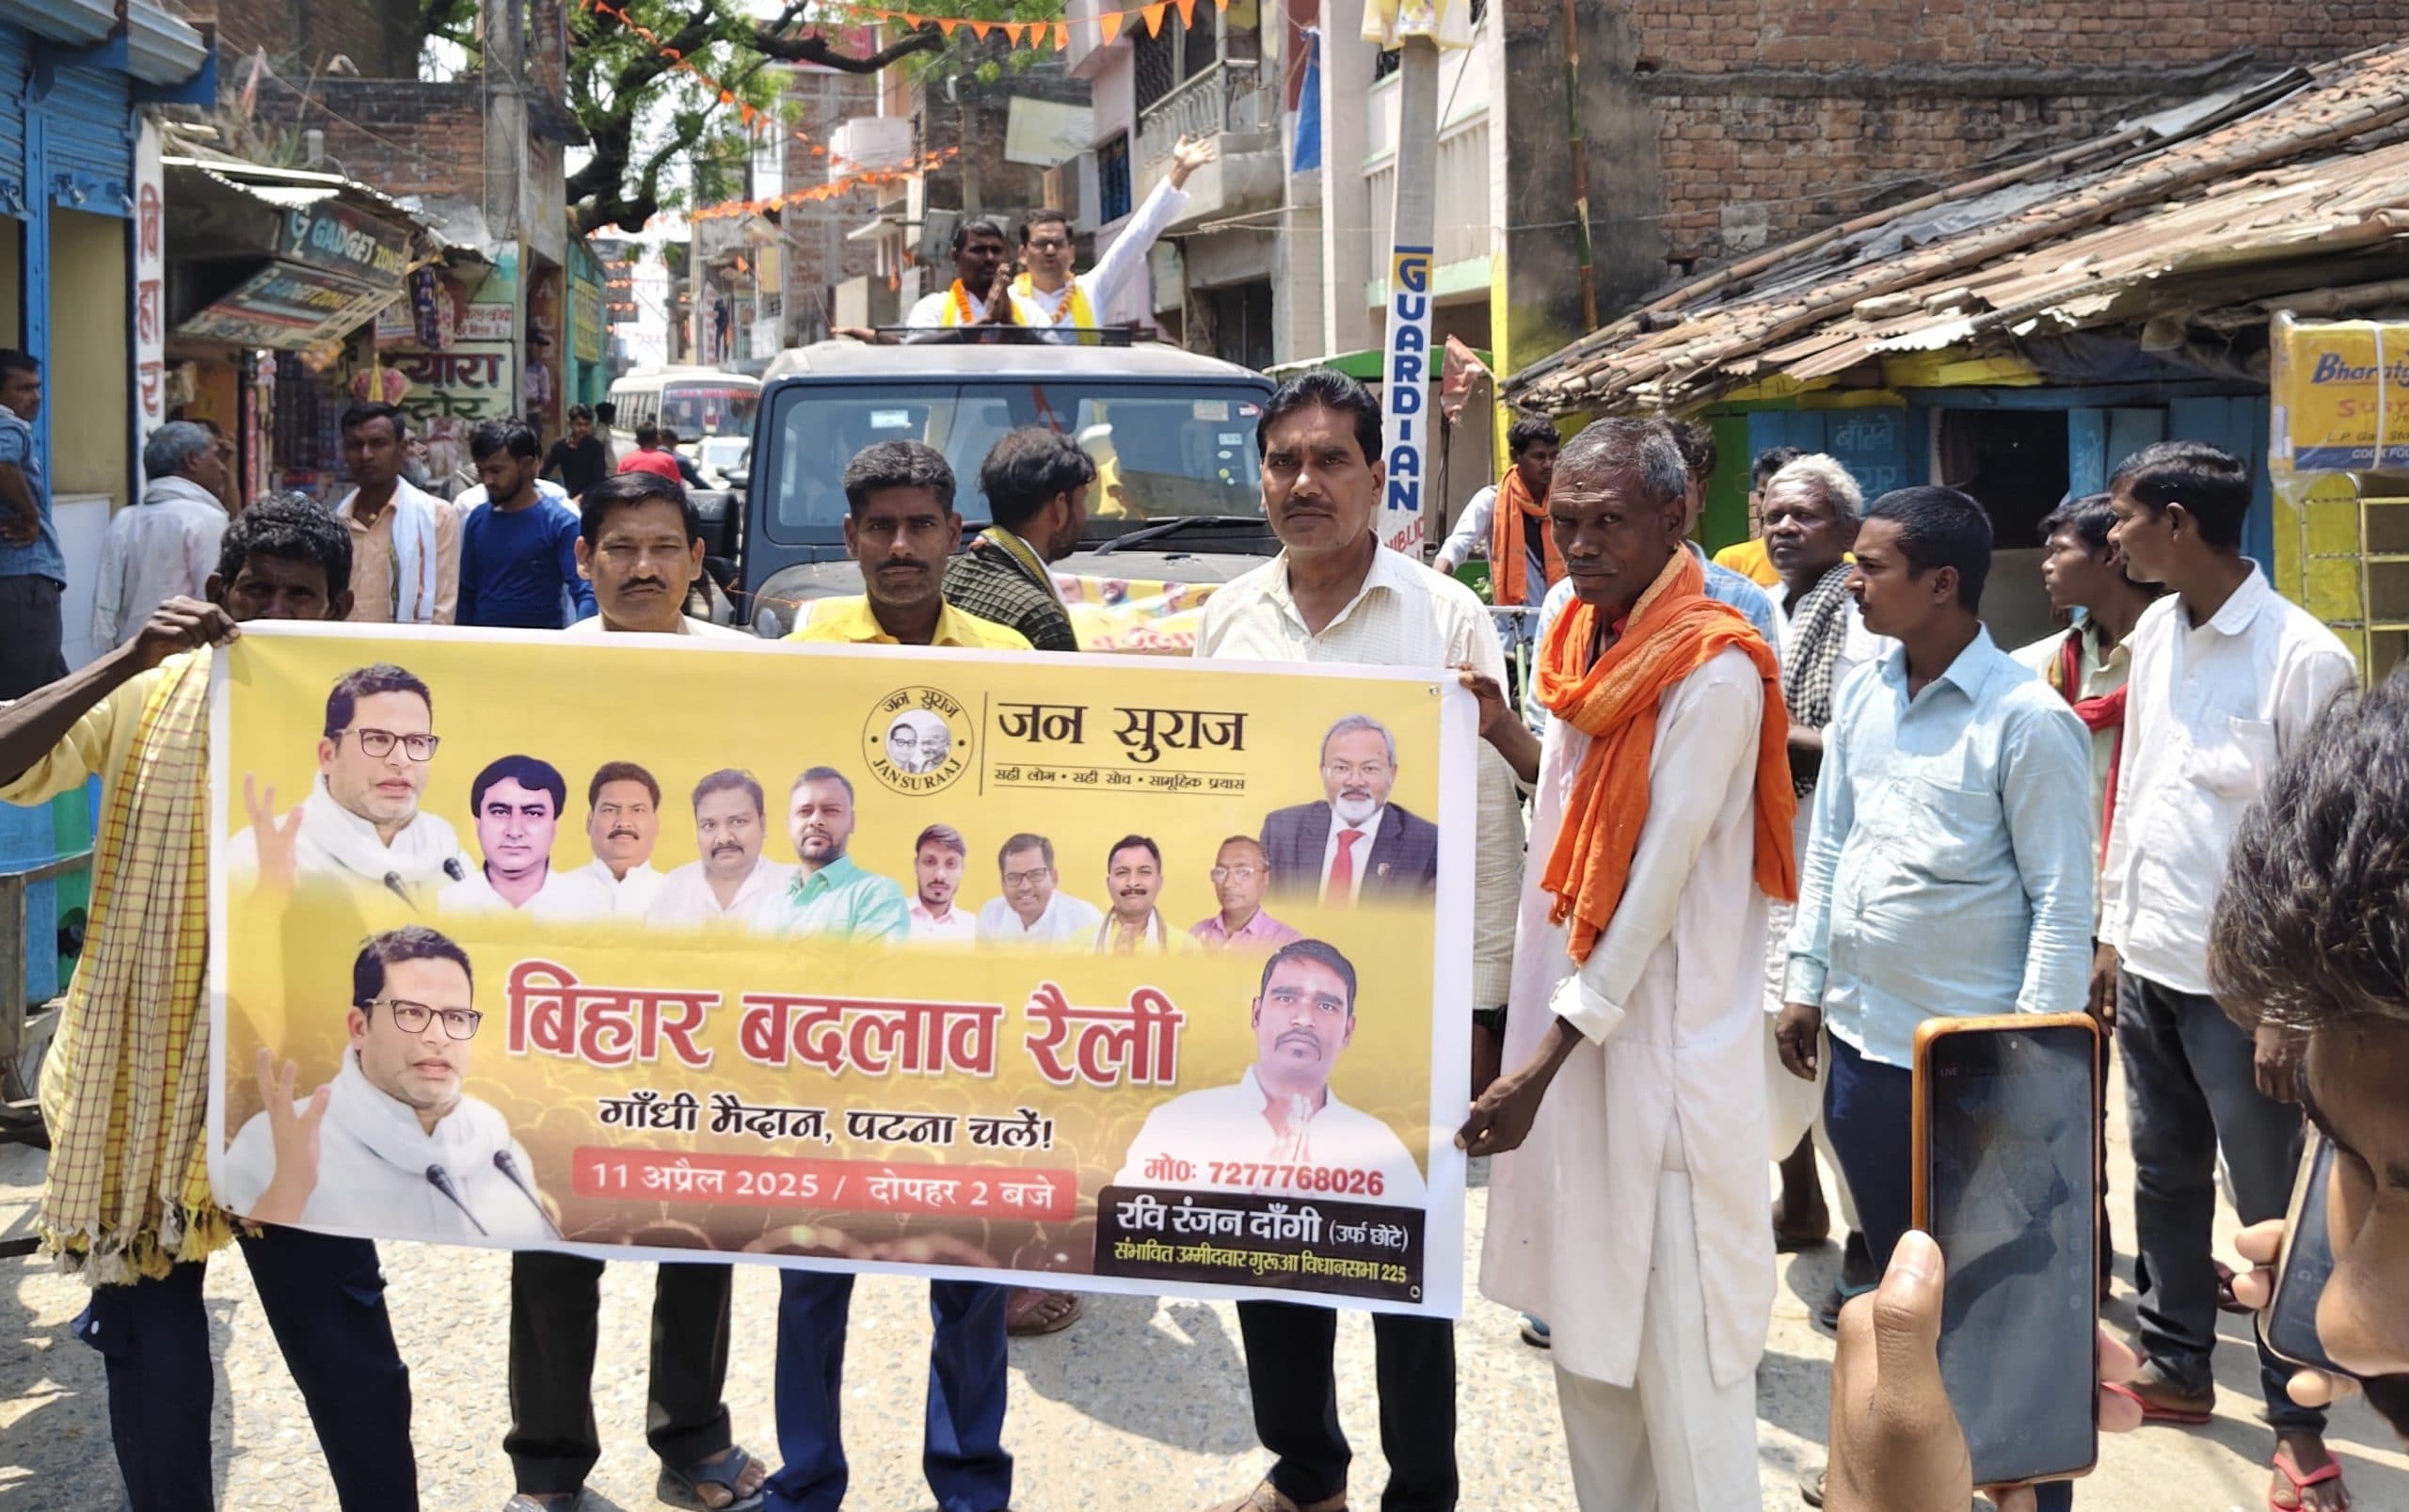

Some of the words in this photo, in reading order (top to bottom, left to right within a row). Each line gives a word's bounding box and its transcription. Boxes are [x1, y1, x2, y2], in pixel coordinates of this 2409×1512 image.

[312, 217, 375, 264] GADGET
[373, 244, 403, 277] ZONE
[399, 390, 491, 421] ्टोर
[1388, 258, 1427, 511] GUARDIAN
[1384, 516, 1425, 552] UBLIC
[882, 692, 910, 712] जन
[920, 691, 961, 719] सुराज
[997, 703, 1088, 743] जन
[1113, 708, 1248, 763] सुराज
[995, 767, 1020, 781] सही
[1073, 770, 1098, 784] सही
[1149, 773, 1203, 791] सामूहिक
[1208, 777, 1245, 789] प्रयास
[507, 961, 720, 1064] बिहार
[741, 995, 1003, 1074] बदलाव
[1026, 982, 1184, 1084] रैली
[598, 1090, 700, 1131] गाँधी
[710, 1094, 833, 1144] मैदान,
[846, 1111, 958, 1144] पटना
[968, 1108, 1053, 1148] चलें!
[592, 1162, 629, 1188] 11
[642, 1157, 726, 1194] अप्रैल
[737, 1171, 819, 1197] 2025
[866, 1168, 960, 1206] दोपहर
[970, 1182, 989, 1205] 2
[999, 1174, 1056, 1209] बजे
[1208, 1161, 1384, 1196] 7277768026
[1116, 1194, 1167, 1232] रवि
[1173, 1195, 1245, 1237] रंजन
[1250, 1202, 1322, 1243] दाँगी
[1115, 1236, 1173, 1264] संभावित
[1176, 1241, 1247, 1268] उम्मीदवार
[1300, 1250, 1379, 1280] विधानसभा
[1380, 1265, 1407, 1283] 225
